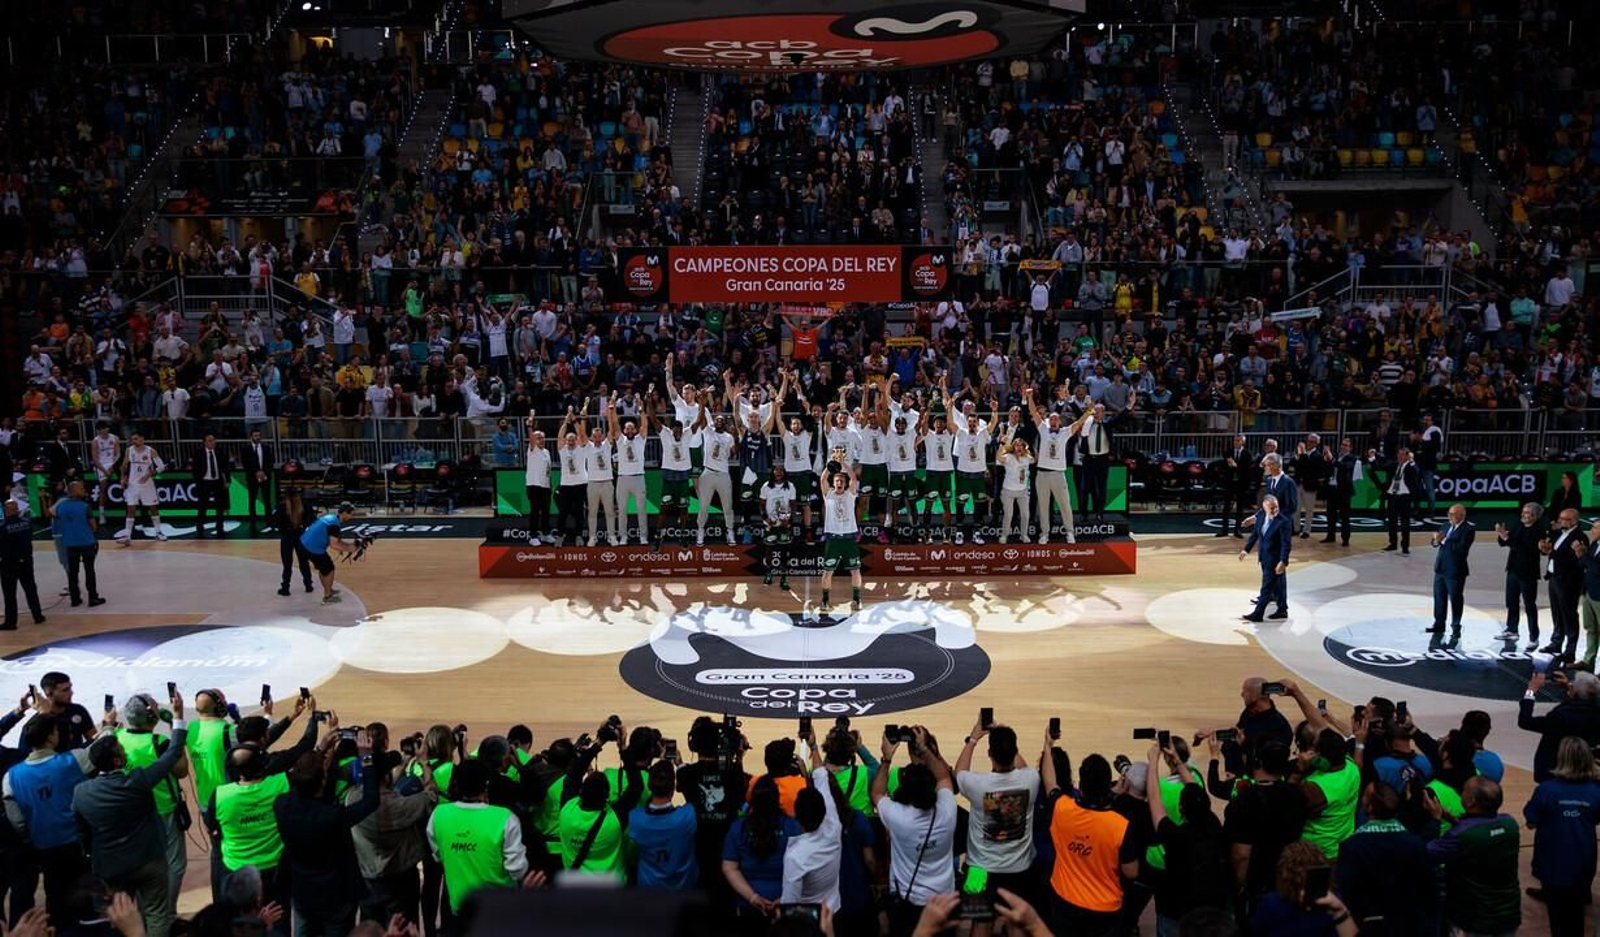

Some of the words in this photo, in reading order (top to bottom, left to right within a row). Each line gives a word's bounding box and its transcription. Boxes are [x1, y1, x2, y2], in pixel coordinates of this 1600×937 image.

[703, 40, 816, 49] acb
[662, 47, 872, 60] Copa
[673, 258, 776, 272] CAMPEONES
[781, 258, 827, 272] COPA
[831, 258, 862, 271] DEL
[865, 258, 896, 271] REY
[630, 271, 650, 279] Copa
[915, 271, 935, 279] Copa
[725, 279, 760, 291] Gran
[764, 278, 822, 291] Canaria
[826, 279, 844, 290] '25
[629, 552, 670, 562] endesa
[953, 550, 995, 560] endesa
[800, 557, 815, 567] del
[704, 672, 765, 681] Gran
[770, 671, 871, 681] Canaria
[875, 671, 907, 680] '25
[740, 686, 857, 701] Copa
[749, 700, 792, 709] del
[797, 700, 875, 715] Rey
[451, 842, 478, 852] MMCC
[1068, 842, 1093, 856] ORG
